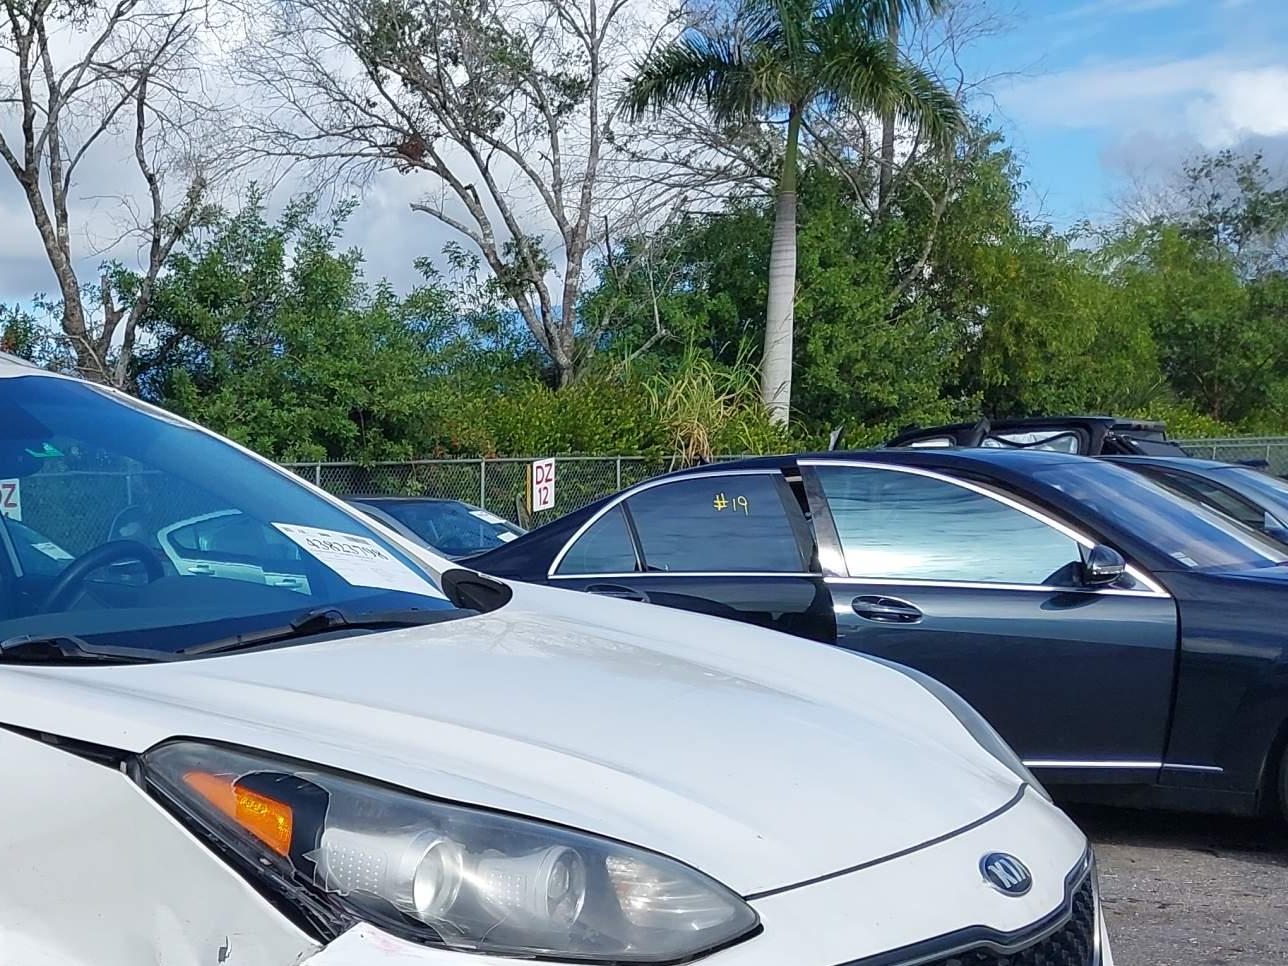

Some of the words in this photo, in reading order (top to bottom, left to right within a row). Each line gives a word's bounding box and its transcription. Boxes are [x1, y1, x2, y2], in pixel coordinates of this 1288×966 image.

[535, 462, 553, 485] DZ
[538, 486, 549, 506] 12
[713, 492, 749, 517] #19
[987, 857, 1028, 889] KIA
